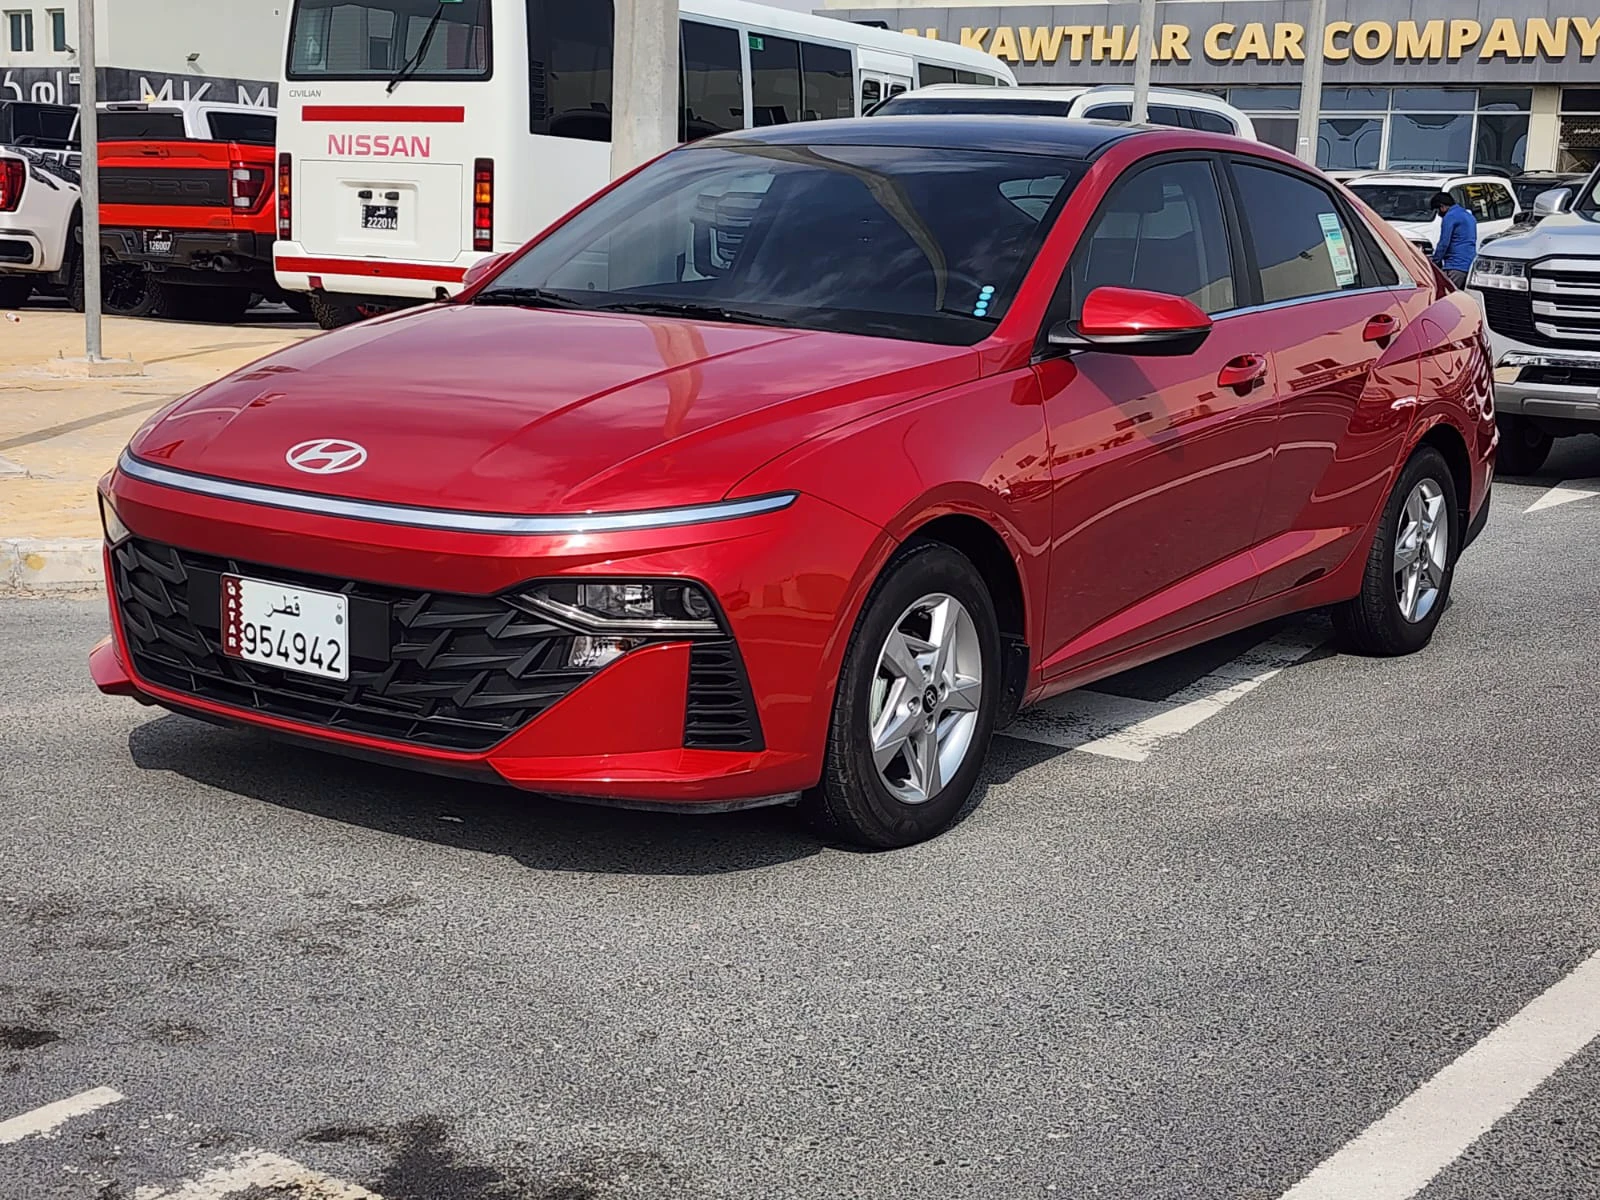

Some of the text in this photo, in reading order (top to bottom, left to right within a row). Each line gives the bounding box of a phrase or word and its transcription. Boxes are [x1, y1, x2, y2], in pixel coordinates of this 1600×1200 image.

[1204, 23, 1306, 60] CAR
[1323, 17, 1600, 60] COMPANY
[289, 89, 321, 98] CIVILIAN
[328, 134, 430, 157] NISSAN
[367, 217, 397, 229] 222014
[149, 240, 171, 251] 126007
[226, 581, 237, 648] QATAR
[264, 595, 300, 618] قطر
[244, 622, 342, 674] 954942
